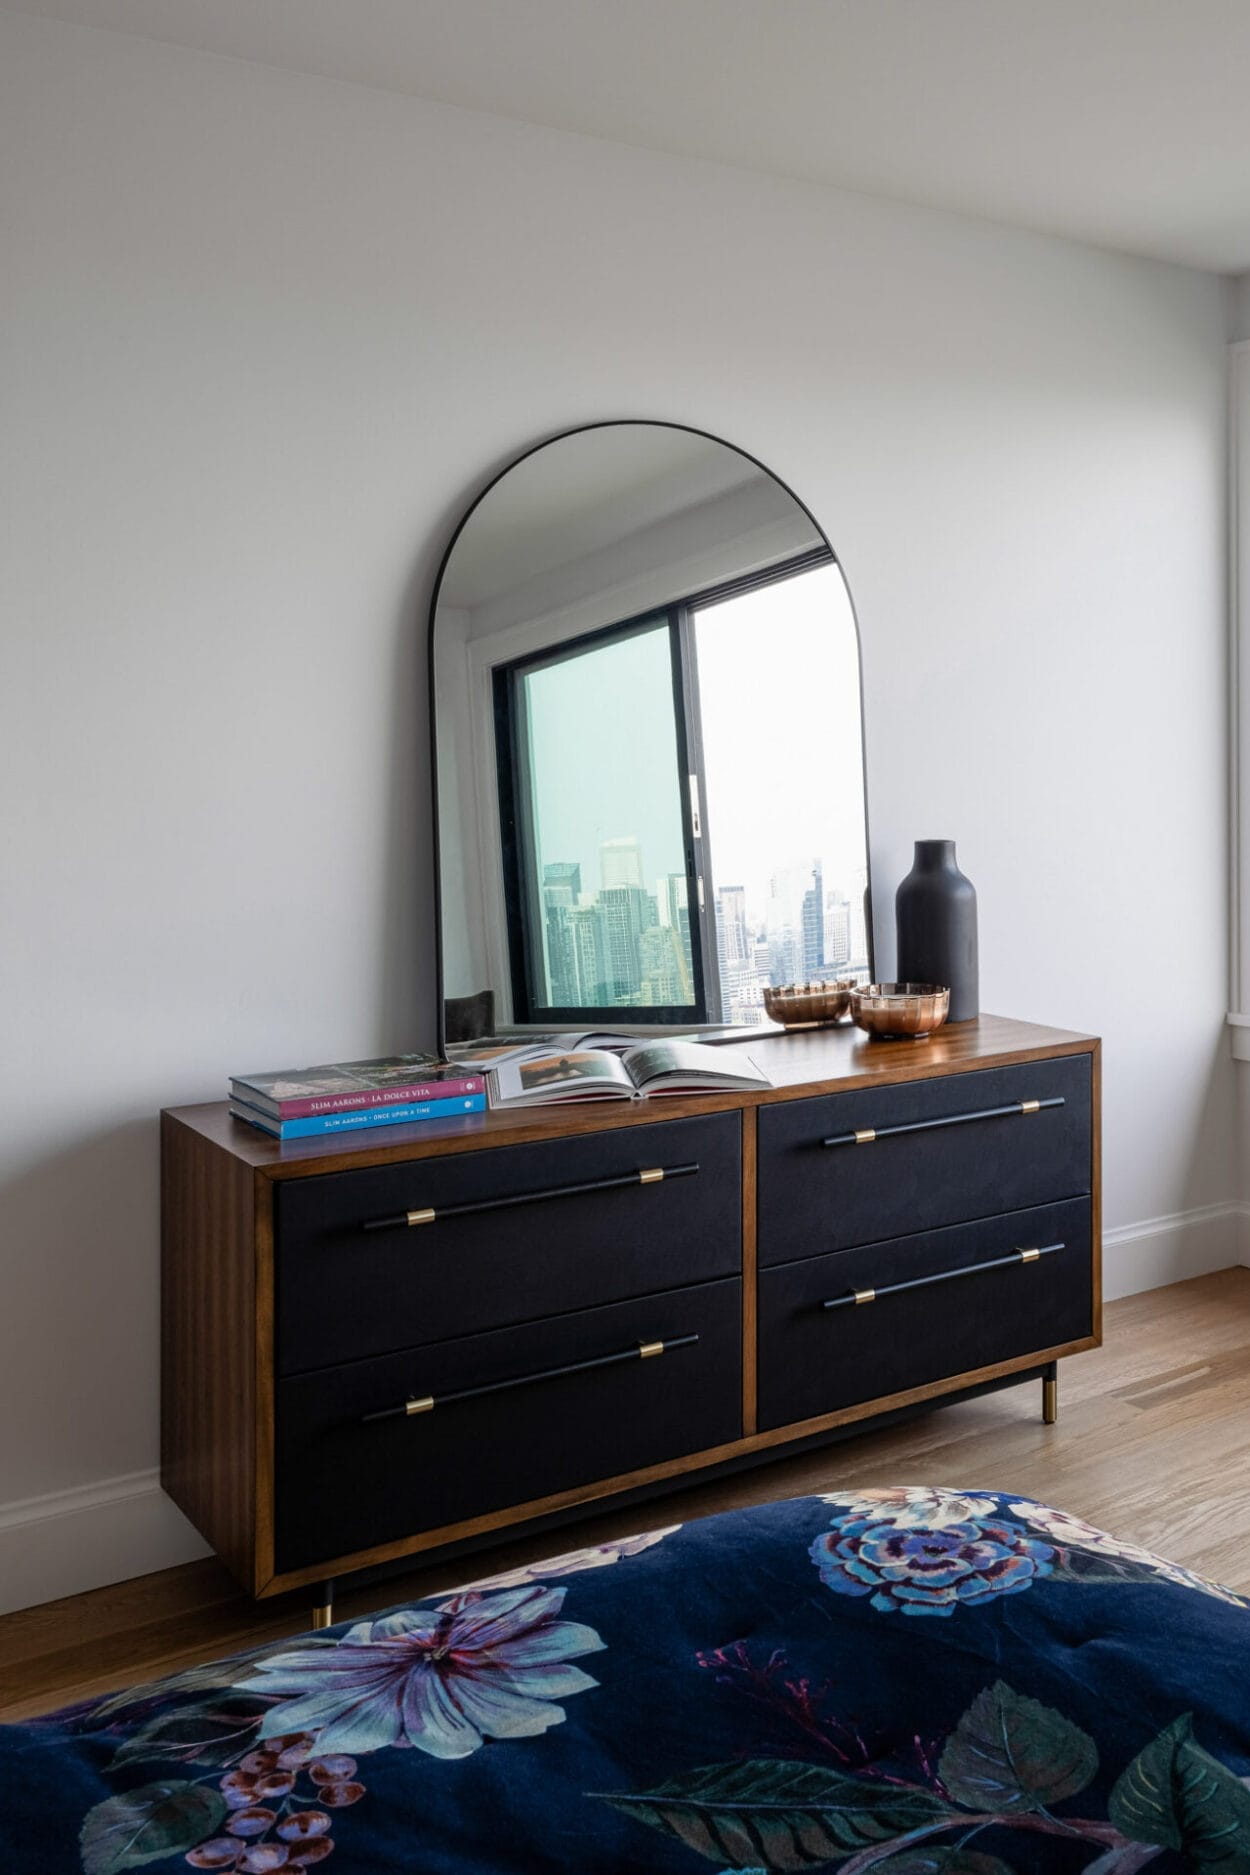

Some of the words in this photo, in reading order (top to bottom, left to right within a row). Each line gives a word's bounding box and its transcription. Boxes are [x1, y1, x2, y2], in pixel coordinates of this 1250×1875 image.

[310, 1100, 331, 1111] SLIM
[332, 1096, 366, 1108] AARONS
[371, 1093, 382, 1103] LA
[384, 1090, 410, 1101] DOLCE
[411, 1088, 430, 1097] VITA
[324, 1119, 340, 1127] SLIM
[342, 1115, 367, 1125] AARONS
[373, 1112, 390, 1121] ONCE
[392, 1110, 408, 1118] UPON
